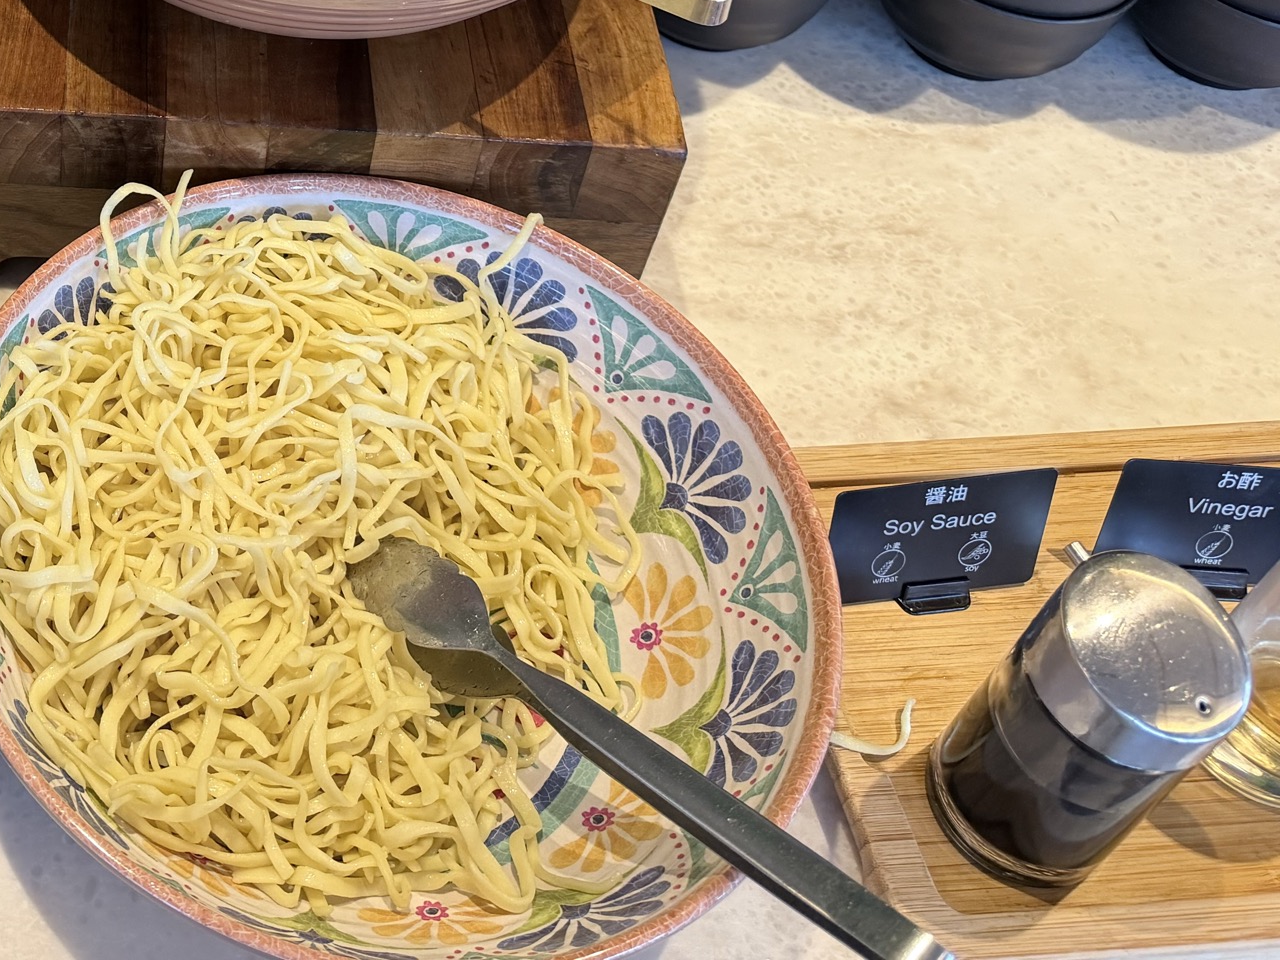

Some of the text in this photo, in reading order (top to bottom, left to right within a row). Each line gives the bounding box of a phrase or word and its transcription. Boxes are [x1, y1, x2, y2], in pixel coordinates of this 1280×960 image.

[1217, 470, 1264, 491] お酢
[924, 484, 969, 506] 醤油
[1188, 497, 1274, 520] Vinegar
[883, 511, 997, 536] Soy Sauce
[969, 530, 989, 540] 大豆
[1194, 558, 1223, 566] wheat
[872, 575, 899, 585] wheat
